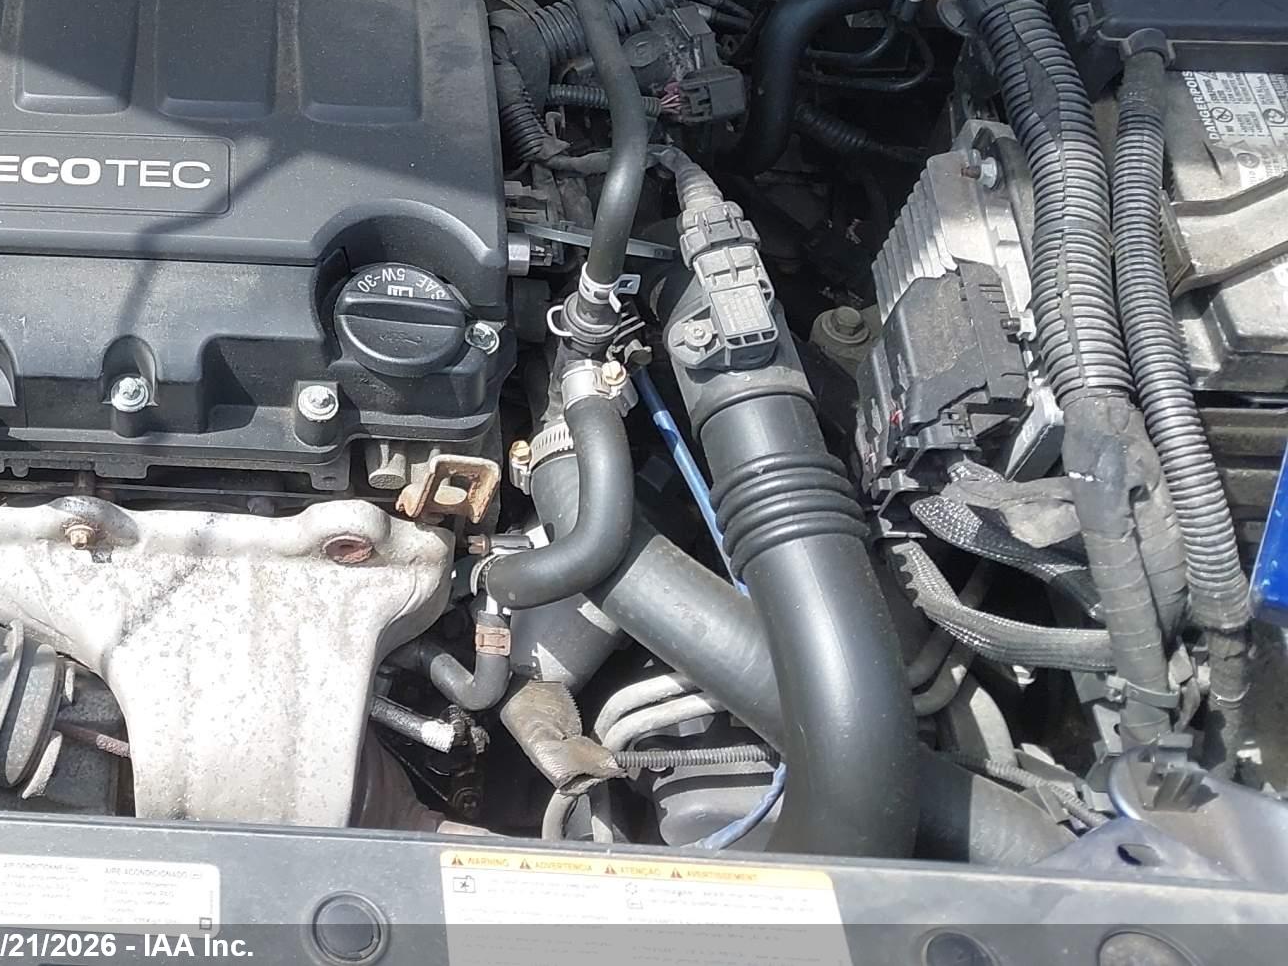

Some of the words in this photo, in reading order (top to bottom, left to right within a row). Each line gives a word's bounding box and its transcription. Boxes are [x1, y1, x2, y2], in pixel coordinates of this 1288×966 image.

[357, 267, 406, 293] 5W-30
[415, 274, 447, 300] SAE
[467, 857, 510, 868] WARNING
